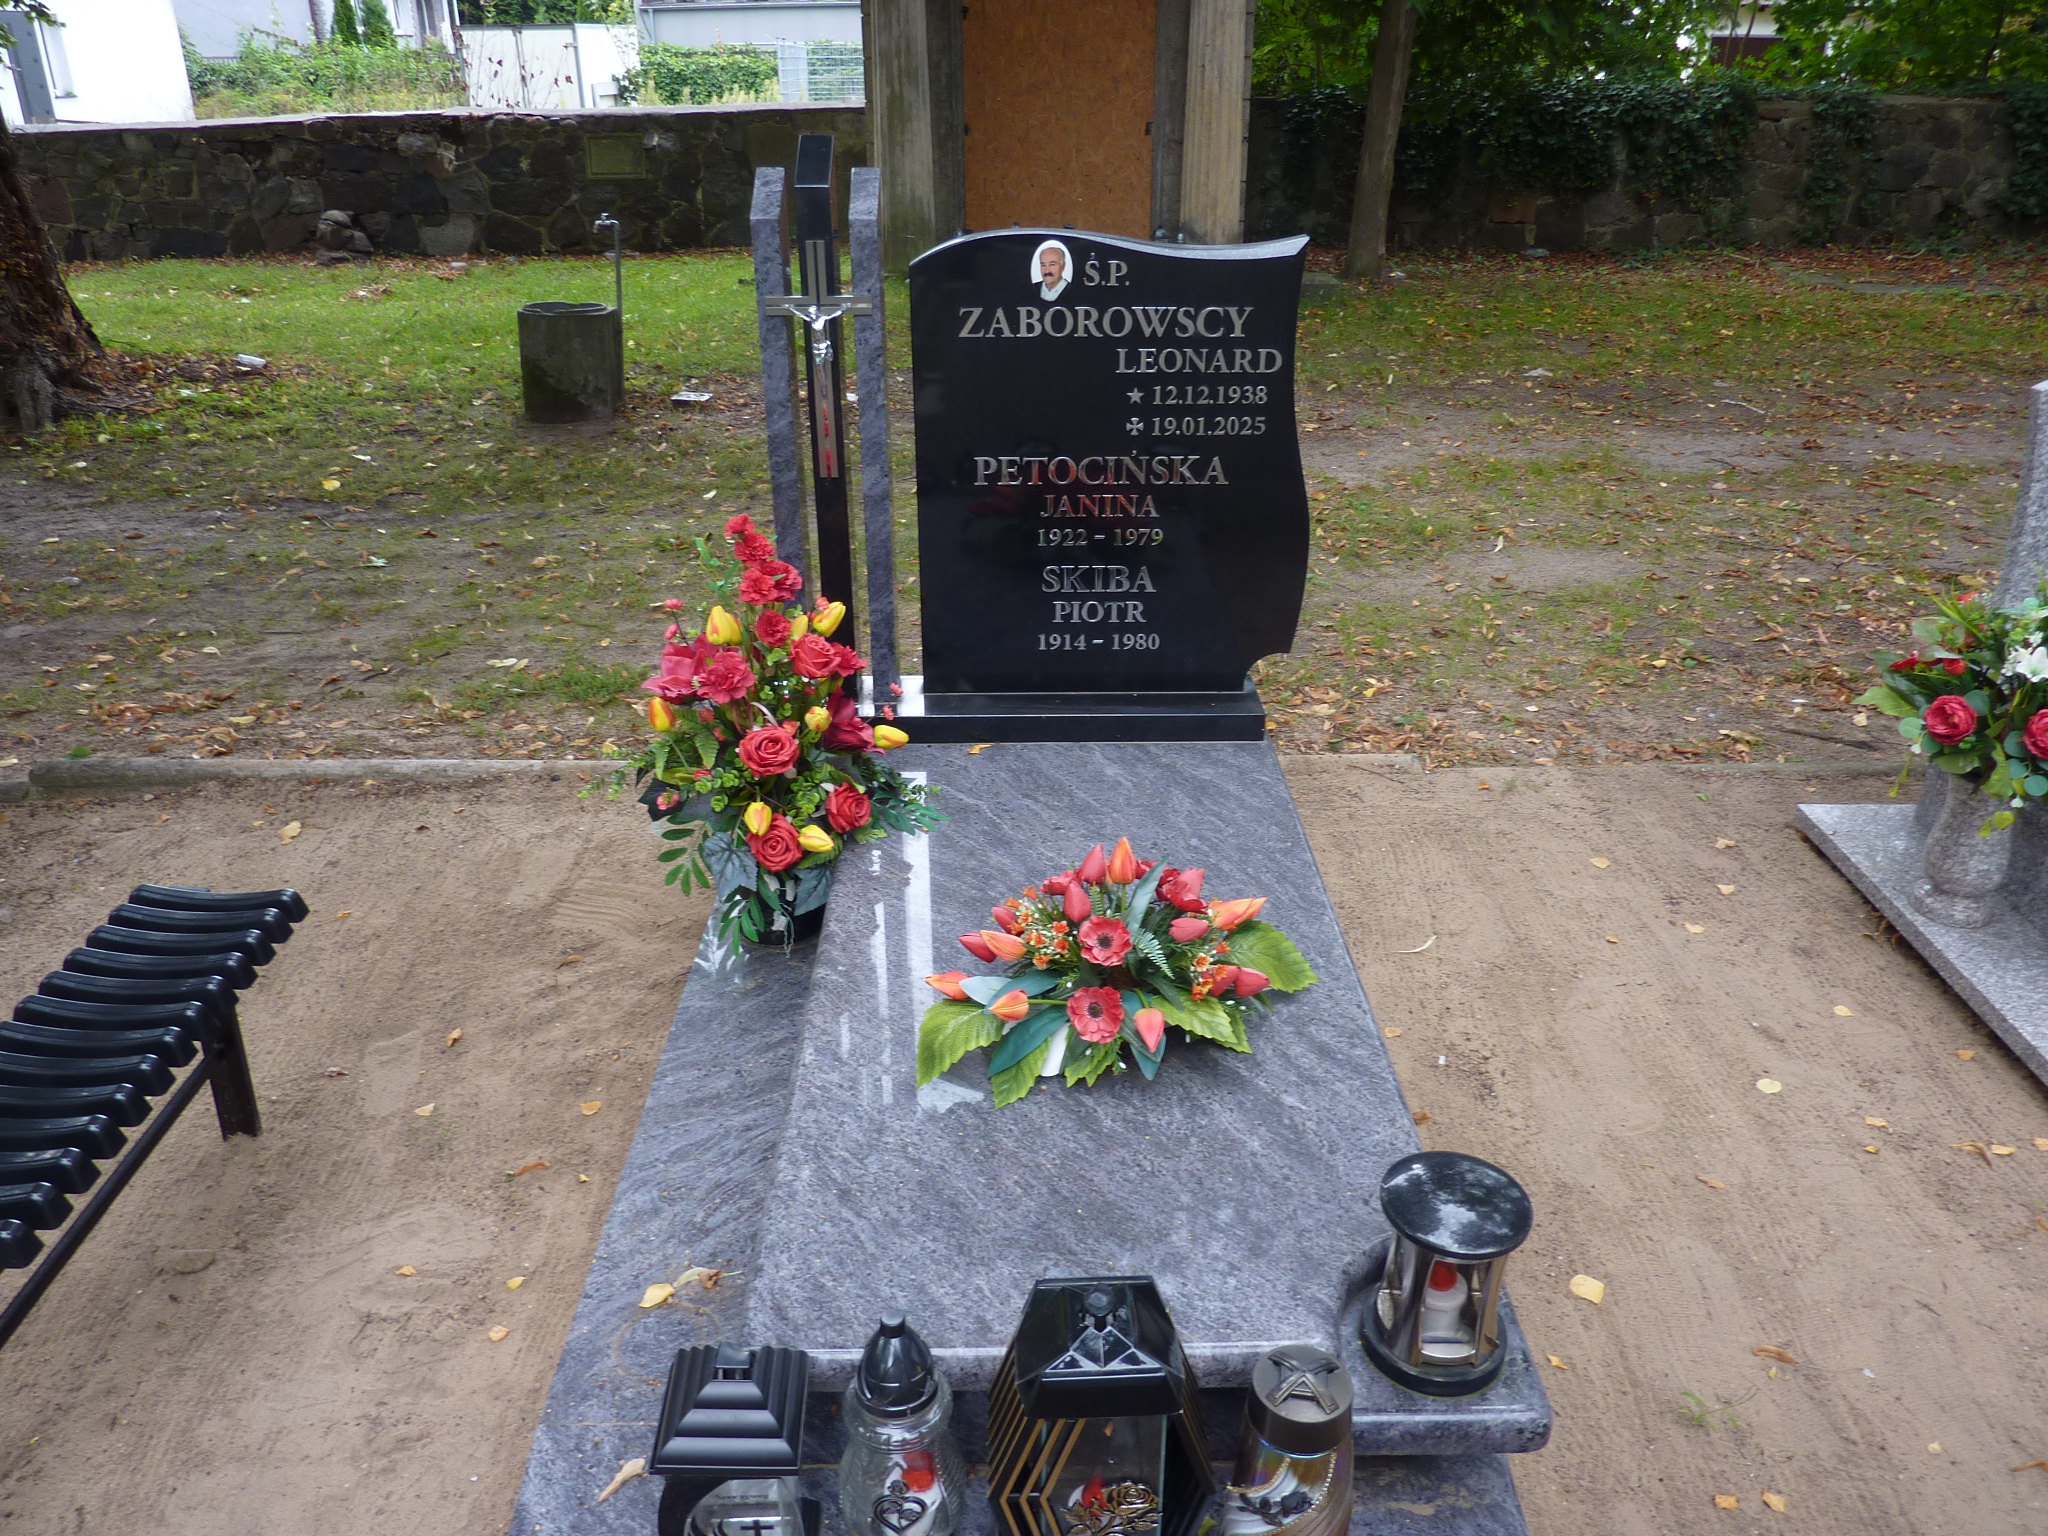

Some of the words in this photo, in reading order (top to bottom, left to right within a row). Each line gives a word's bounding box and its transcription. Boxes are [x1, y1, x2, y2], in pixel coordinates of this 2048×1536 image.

[1083, 253, 1130, 287] Ś.P.
[958, 306, 1254, 338] ZABOROWSCY
[1115, 348, 1283, 374] LEONARD
[1152, 386, 1268, 405] 12.12.1938
[1151, 416, 1266, 436] 19.01.2025
[974, 450, 1228, 486] PETOCIŃSKA
[1040, 495, 1160, 518] JANINA
[1037, 529, 1088, 547] 1922
[1113, 528, 1164, 547] 1979
[1042, 566, 1156, 593] SKIBA
[1052, 601, 1146, 623] PIOTR
[1038, 634, 1086, 651] 1914
[1111, 633, 1160, 651] 1980
